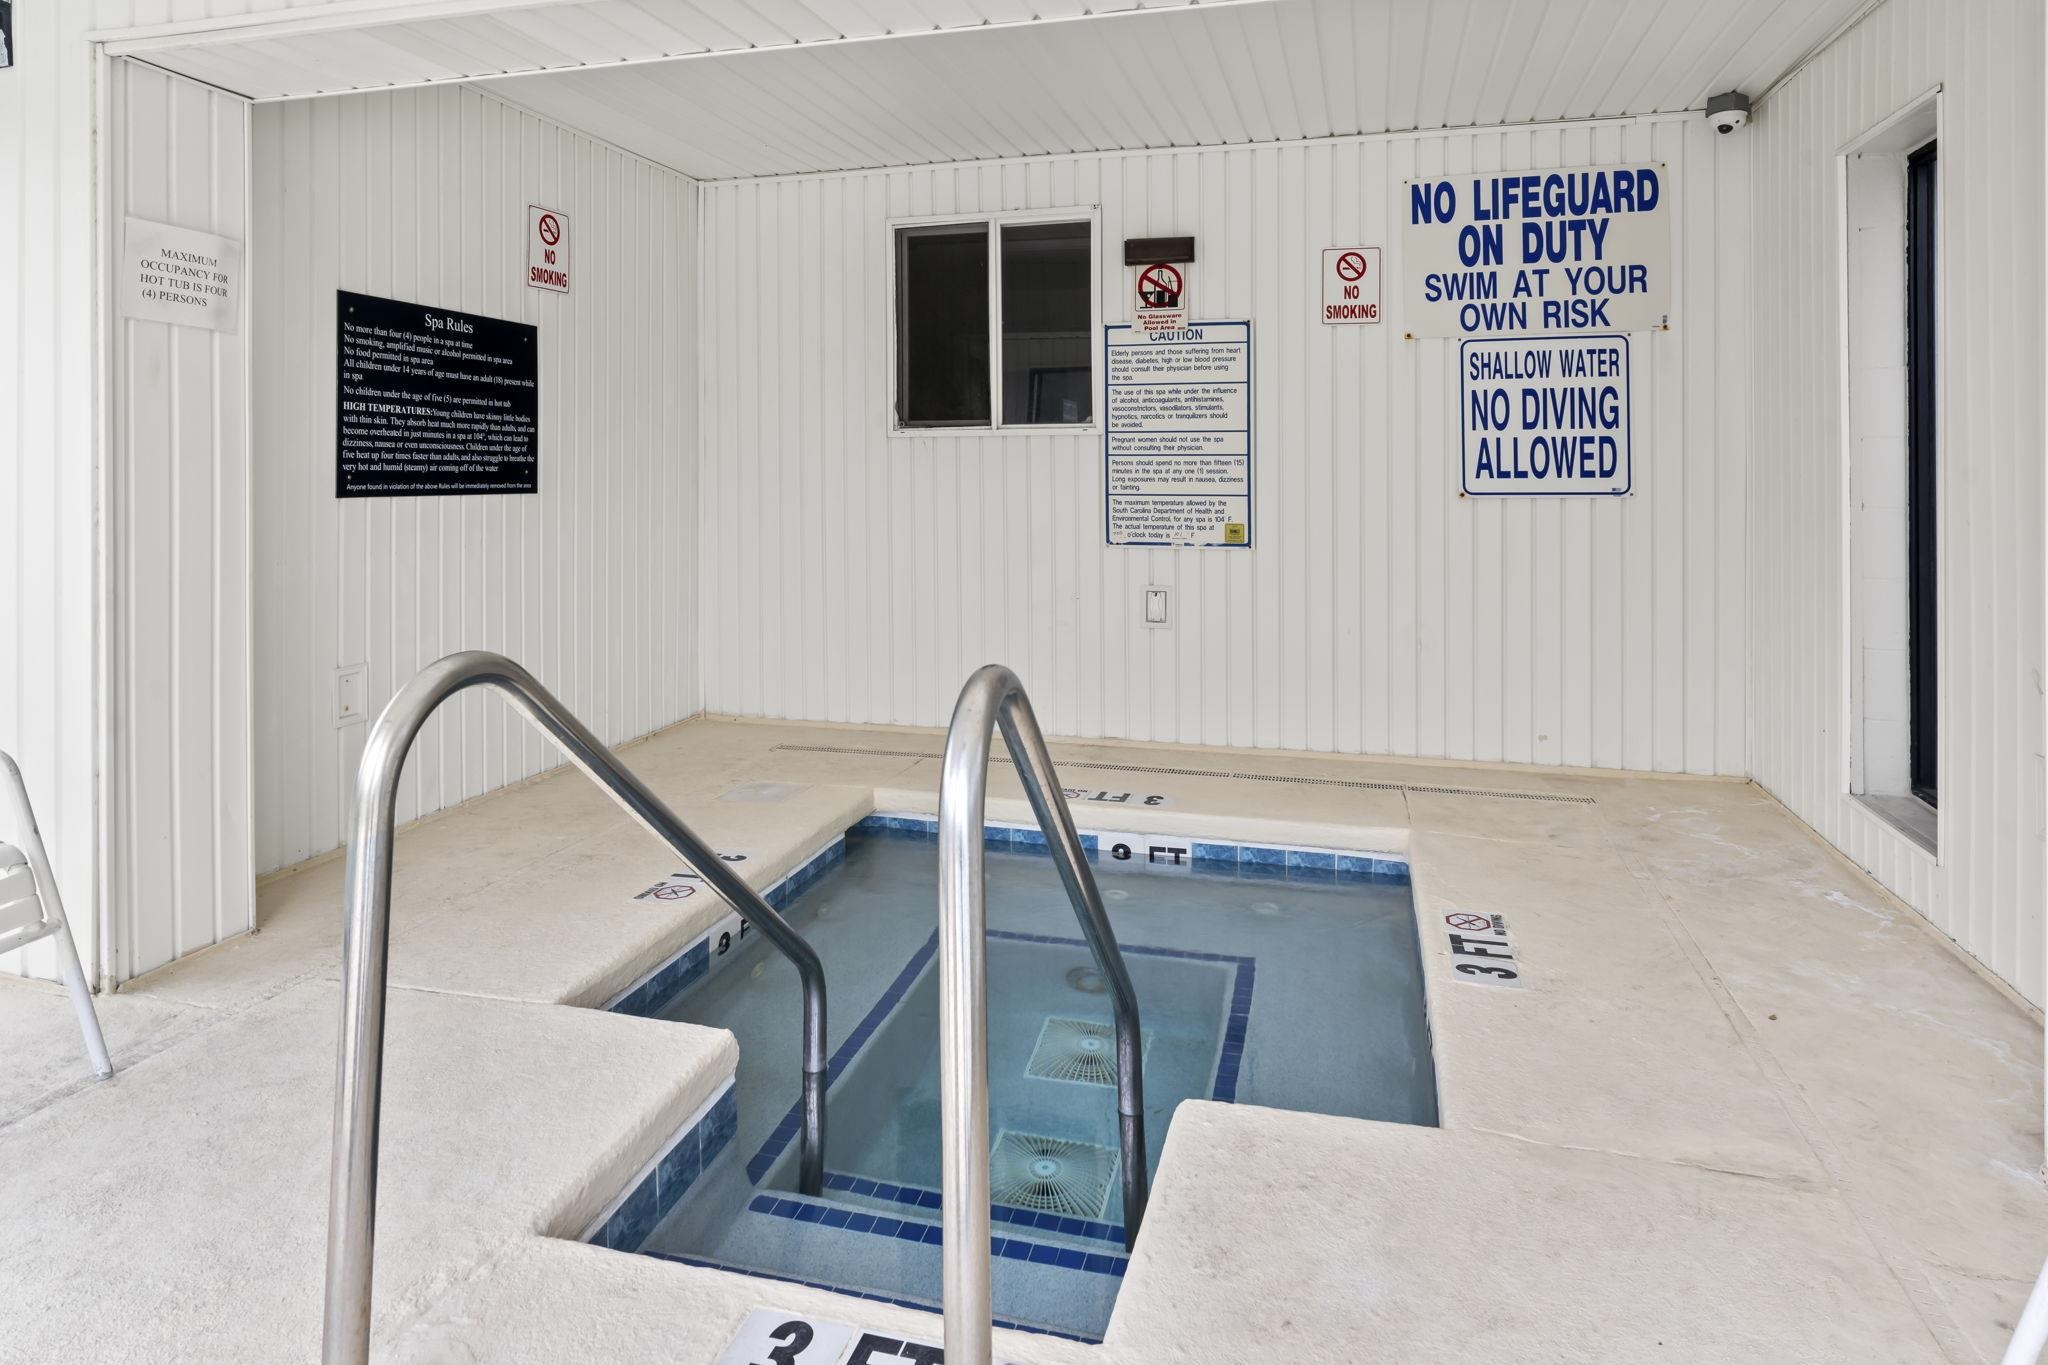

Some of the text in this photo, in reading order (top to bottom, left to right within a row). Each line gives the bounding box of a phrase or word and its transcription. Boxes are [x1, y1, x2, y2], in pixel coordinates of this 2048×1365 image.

[1411, 169, 1659, 225] NO LIFEGUARD
[1459, 218, 1609, 267] ON DUTY
[161, 249, 217, 267] MAXIMUM
[545, 248, 555, 265] NO
[140, 259, 228, 284] OCCUPANCY FOR
[531, 266, 567, 288] SMOKING
[140, 274, 228, 297] HOT TUB IS FOUR
[1344, 285, 1360, 299] NO
[1425, 264, 1648, 302] SWIM AT YOUR
[142, 288, 208, 307] (4) PERSONS
[1326, 304, 1376, 319] SMOKING
[1460, 298, 1611, 332] OWN RISK
[425, 313, 473, 334] Spa Rules
[344, 322, 354, 332] No
[356, 326, 372, 334] more
[374, 327, 387, 336] than
[389, 329, 402, 338] four
[403, 331, 412, 342] (4)
[413, 333, 432, 344] people
[434, 336, 439, 344] in
[445, 339, 454, 348] spa
[455, 339, 460, 347] at
[344, 334, 354, 344] No
[386, 340, 415, 354] amplified
[416, 344, 433, 354] music
[442, 348, 461, 358] alcohol
[487, 354, 492, 362] in
[493, 357, 501, 365] spa
[344, 346, 354, 355] No
[356, 348, 371, 357] food
[372, 350, 401, 363] permitted
[403, 354, 409, 362] in
[410, 357, 420, 365] spa
[1111, 350, 1129, 358] Elderly
[1185, 347, 1209, 356] suffering
[1469, 349, 1620, 380] SHALLOW WATER
[343, 385, 354, 394] No
[355, 386, 381, 397] children
[383, 389, 400, 398] under
[402, 391, 411, 399] the
[412, 394, 422, 402] age
[424, 393, 431, 401] of
[432, 393, 442, 402] five
[443, 394, 452, 404] (5)
[343, 401, 366, 411] HIGH
[1472, 386, 1619, 431] NO DIVING
[1476, 435, 1618, 479] ALLOWED
[1088, 791, 1164, 805] 3 FT
[1449, 934, 1518, 979] 3 FT
